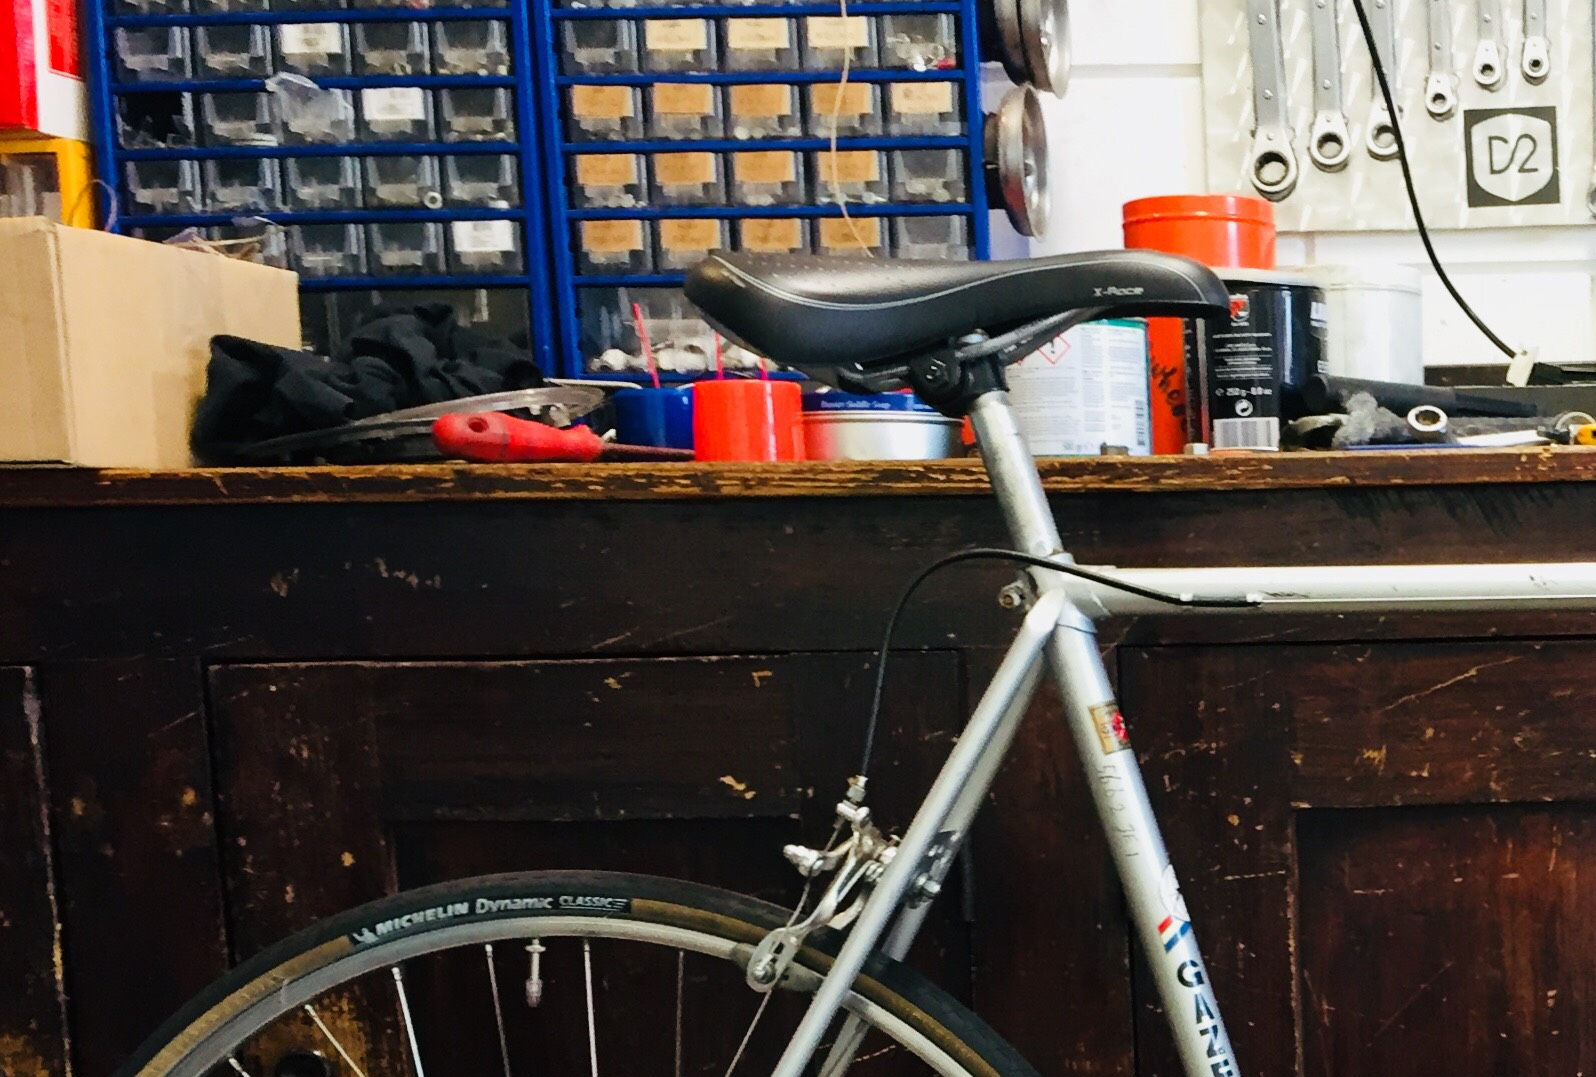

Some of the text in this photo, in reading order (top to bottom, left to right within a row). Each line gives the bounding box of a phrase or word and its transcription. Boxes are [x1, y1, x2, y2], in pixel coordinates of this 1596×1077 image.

[1488, 133, 1539, 175] D2
[376, 895, 620, 936] MICHELIN Dynamic CLASSIC
